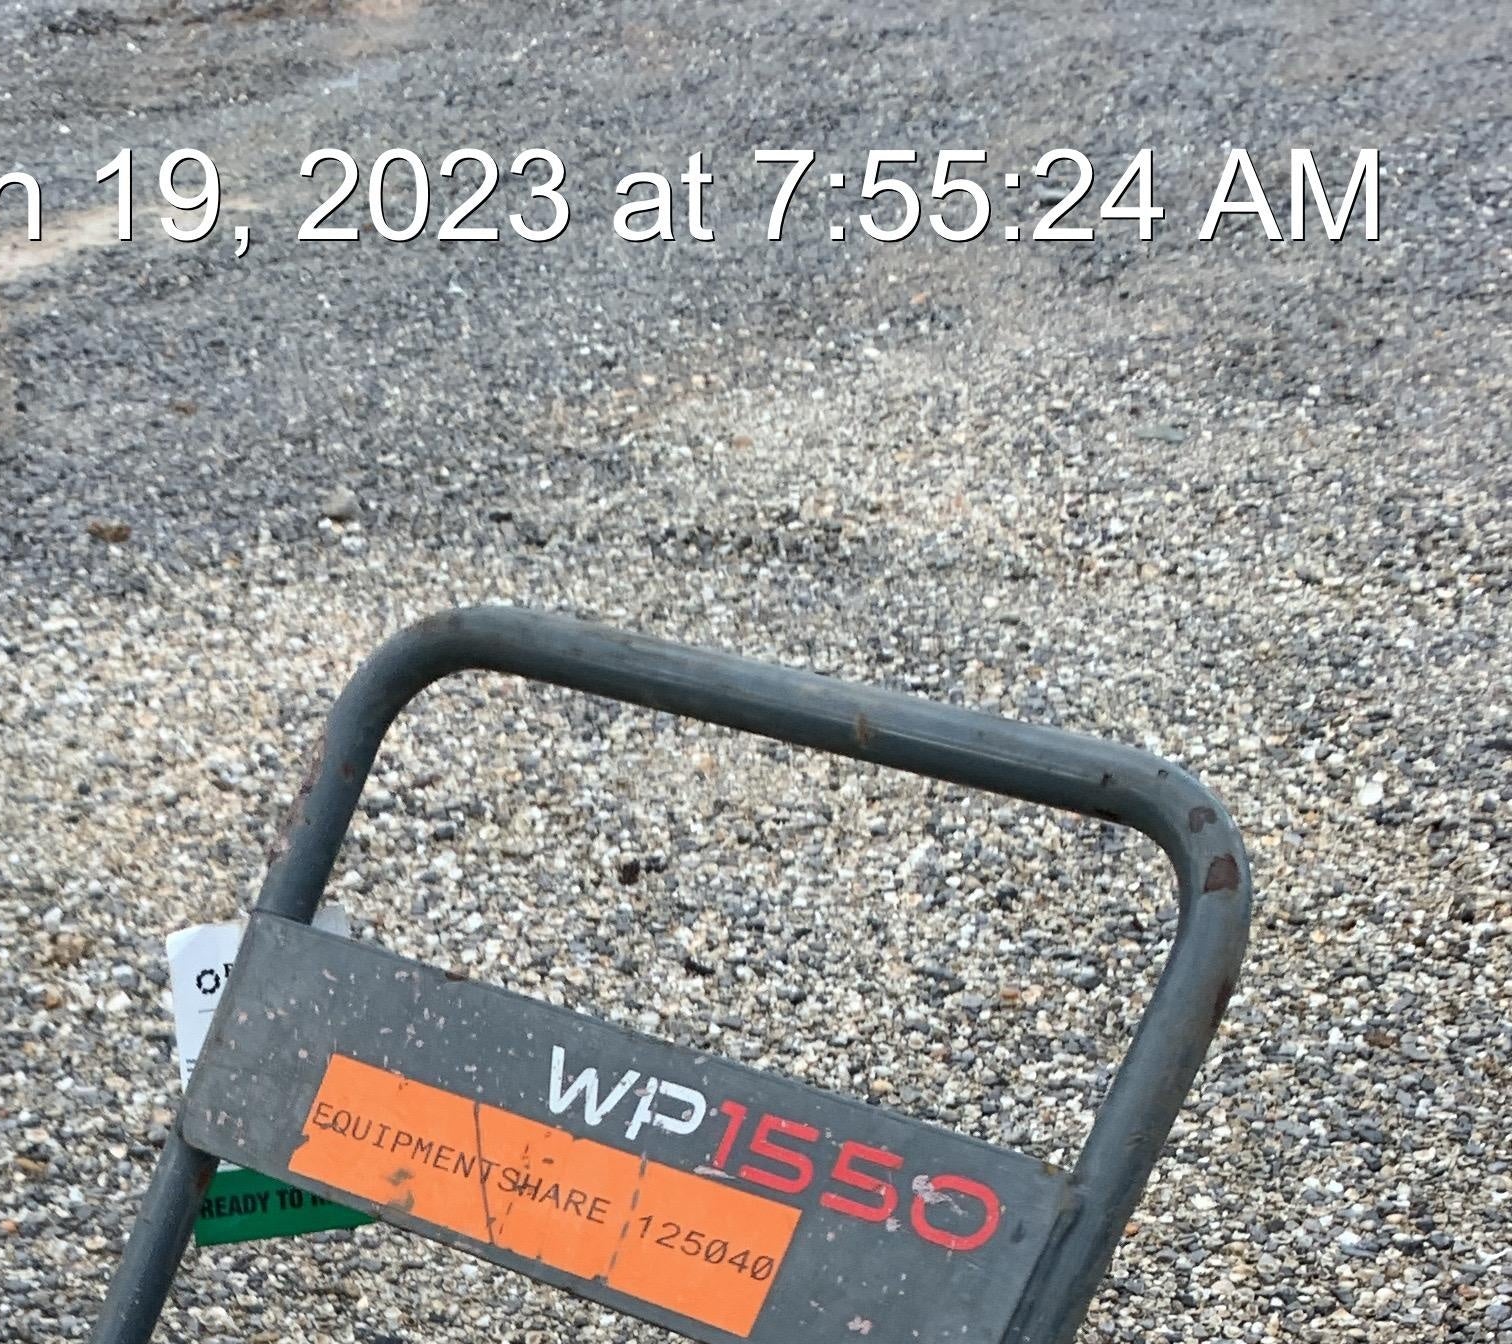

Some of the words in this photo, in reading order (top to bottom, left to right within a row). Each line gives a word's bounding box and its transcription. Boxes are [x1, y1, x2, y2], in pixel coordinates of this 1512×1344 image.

[201, 1191, 270, 1218] READY
[276, 1188, 303, 1210] TO
[311, 1101, 612, 1225] EQUIPMENTSHARE
[639, 1215, 774, 1282] 125040
[548, 1045, 1001, 1252] WP1550
